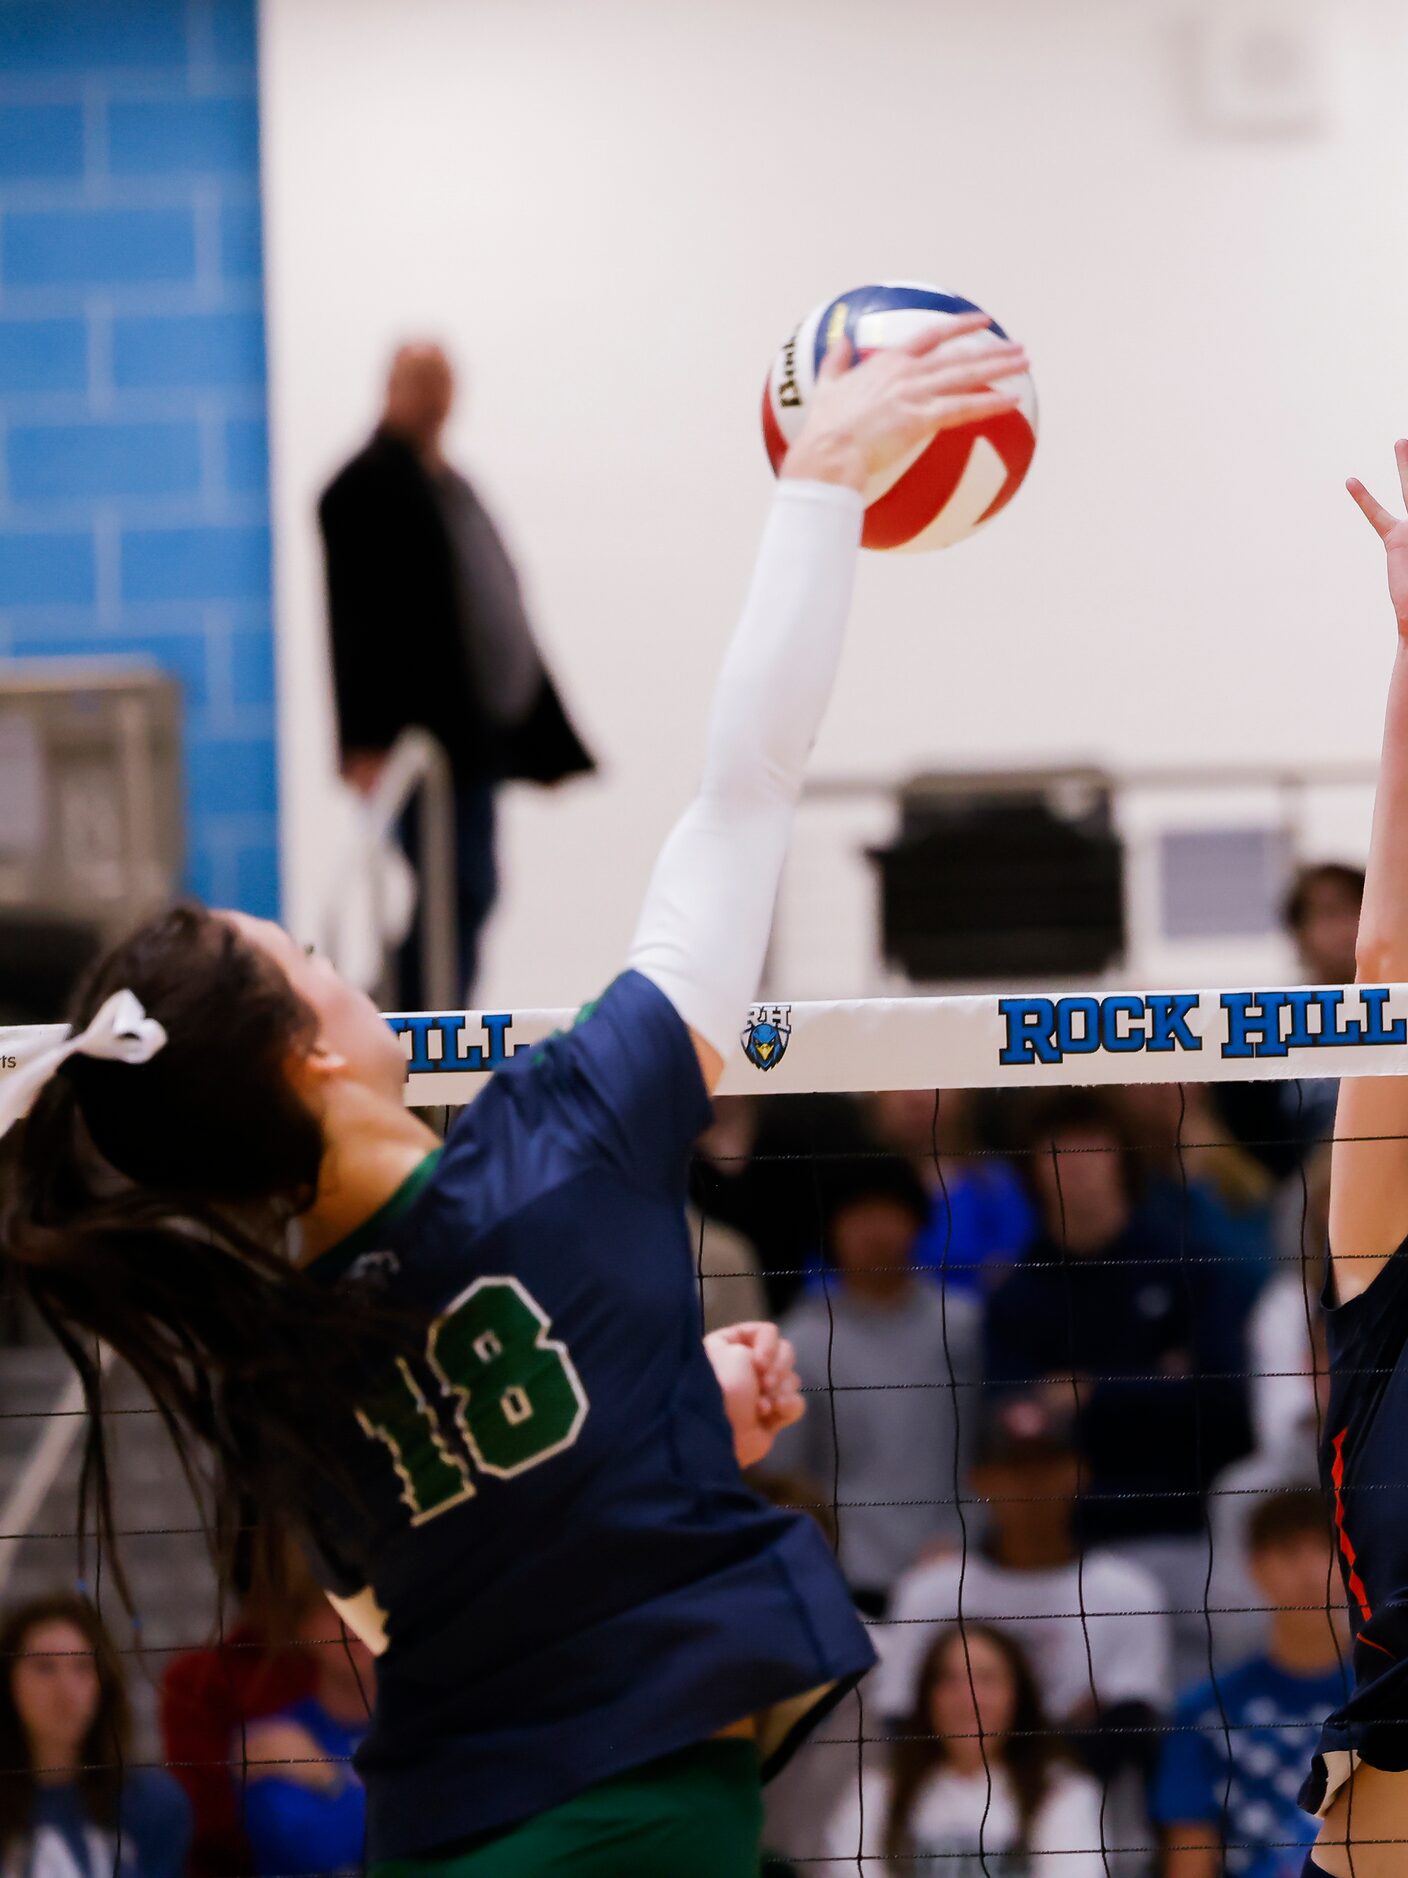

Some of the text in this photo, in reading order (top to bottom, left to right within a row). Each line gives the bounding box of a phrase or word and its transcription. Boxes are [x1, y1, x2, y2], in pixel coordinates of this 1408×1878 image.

[0, 1055, 17, 1069] ts
[386, 1014, 531, 1082] ILL
[998, 988, 1407, 1065] ROCK HILL
[353, 1275, 590, 1527] 18
